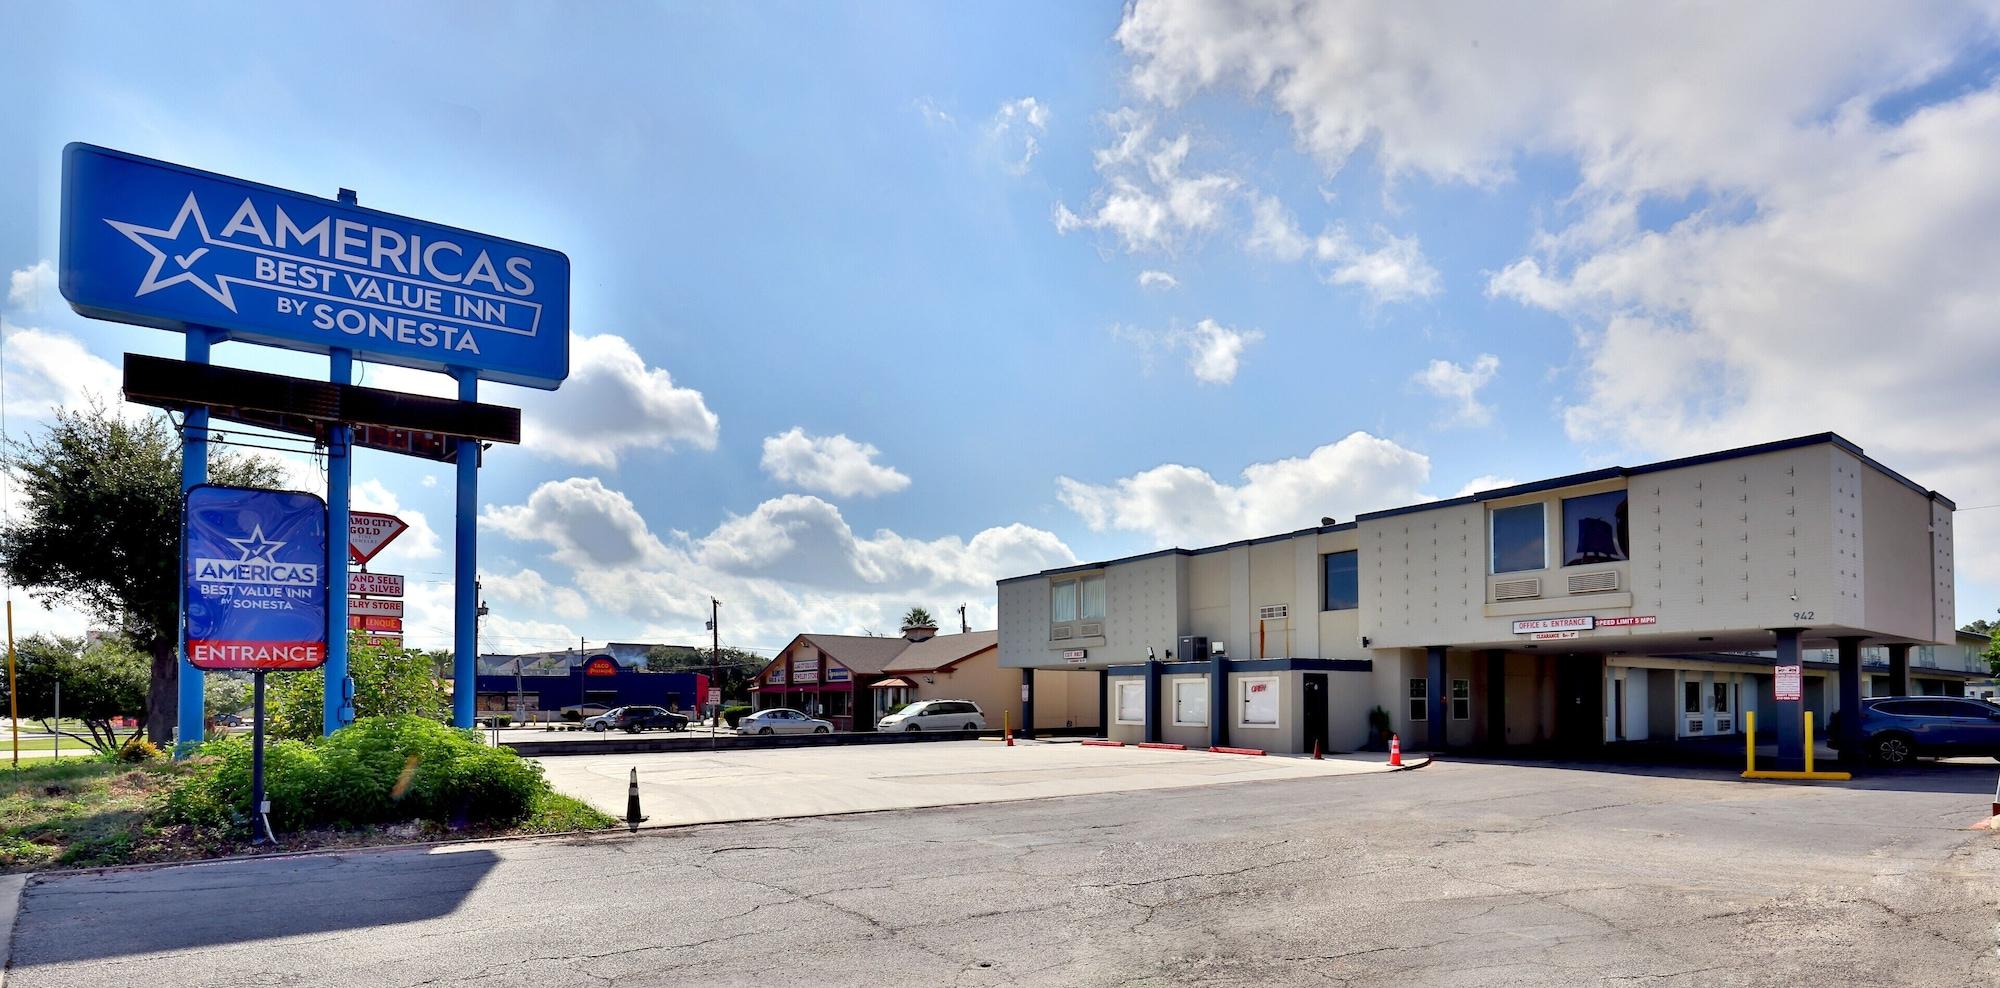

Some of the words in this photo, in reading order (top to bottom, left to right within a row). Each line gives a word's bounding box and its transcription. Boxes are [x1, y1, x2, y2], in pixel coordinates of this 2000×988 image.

[220, 197, 535, 296] AMERICAS
[255, 256, 336, 292] BEST
[344, 273, 441, 312] VALUE
[454, 294, 506, 325] INN
[277, 297, 309, 316] BY
[312, 304, 480, 355] SONESTA
[372, 519, 393, 527] CITY
[350, 526, 380, 535] GOLD
[199, 562, 315, 583] AMERICAS
[353, 575, 374, 583] AND
[378, 576, 399, 585] SELL
[200, 584, 235, 596] BEST
[239, 586, 282, 597] VALUE
[287, 588, 312, 598] INN
[370, 584, 401, 594] SILVER
[233, 599, 293, 610] SONESTA
[349, 600, 370, 608] ELRY
[373, 602, 401, 610] STORE
[1793, 611, 1815, 620] 942
[1519, 621, 1540, 630] OFFICE
[1543, 620, 1549, 628] &
[1551, 618, 1586, 628] ENTRANCE
[194, 645, 318, 661] ENTRANCE
